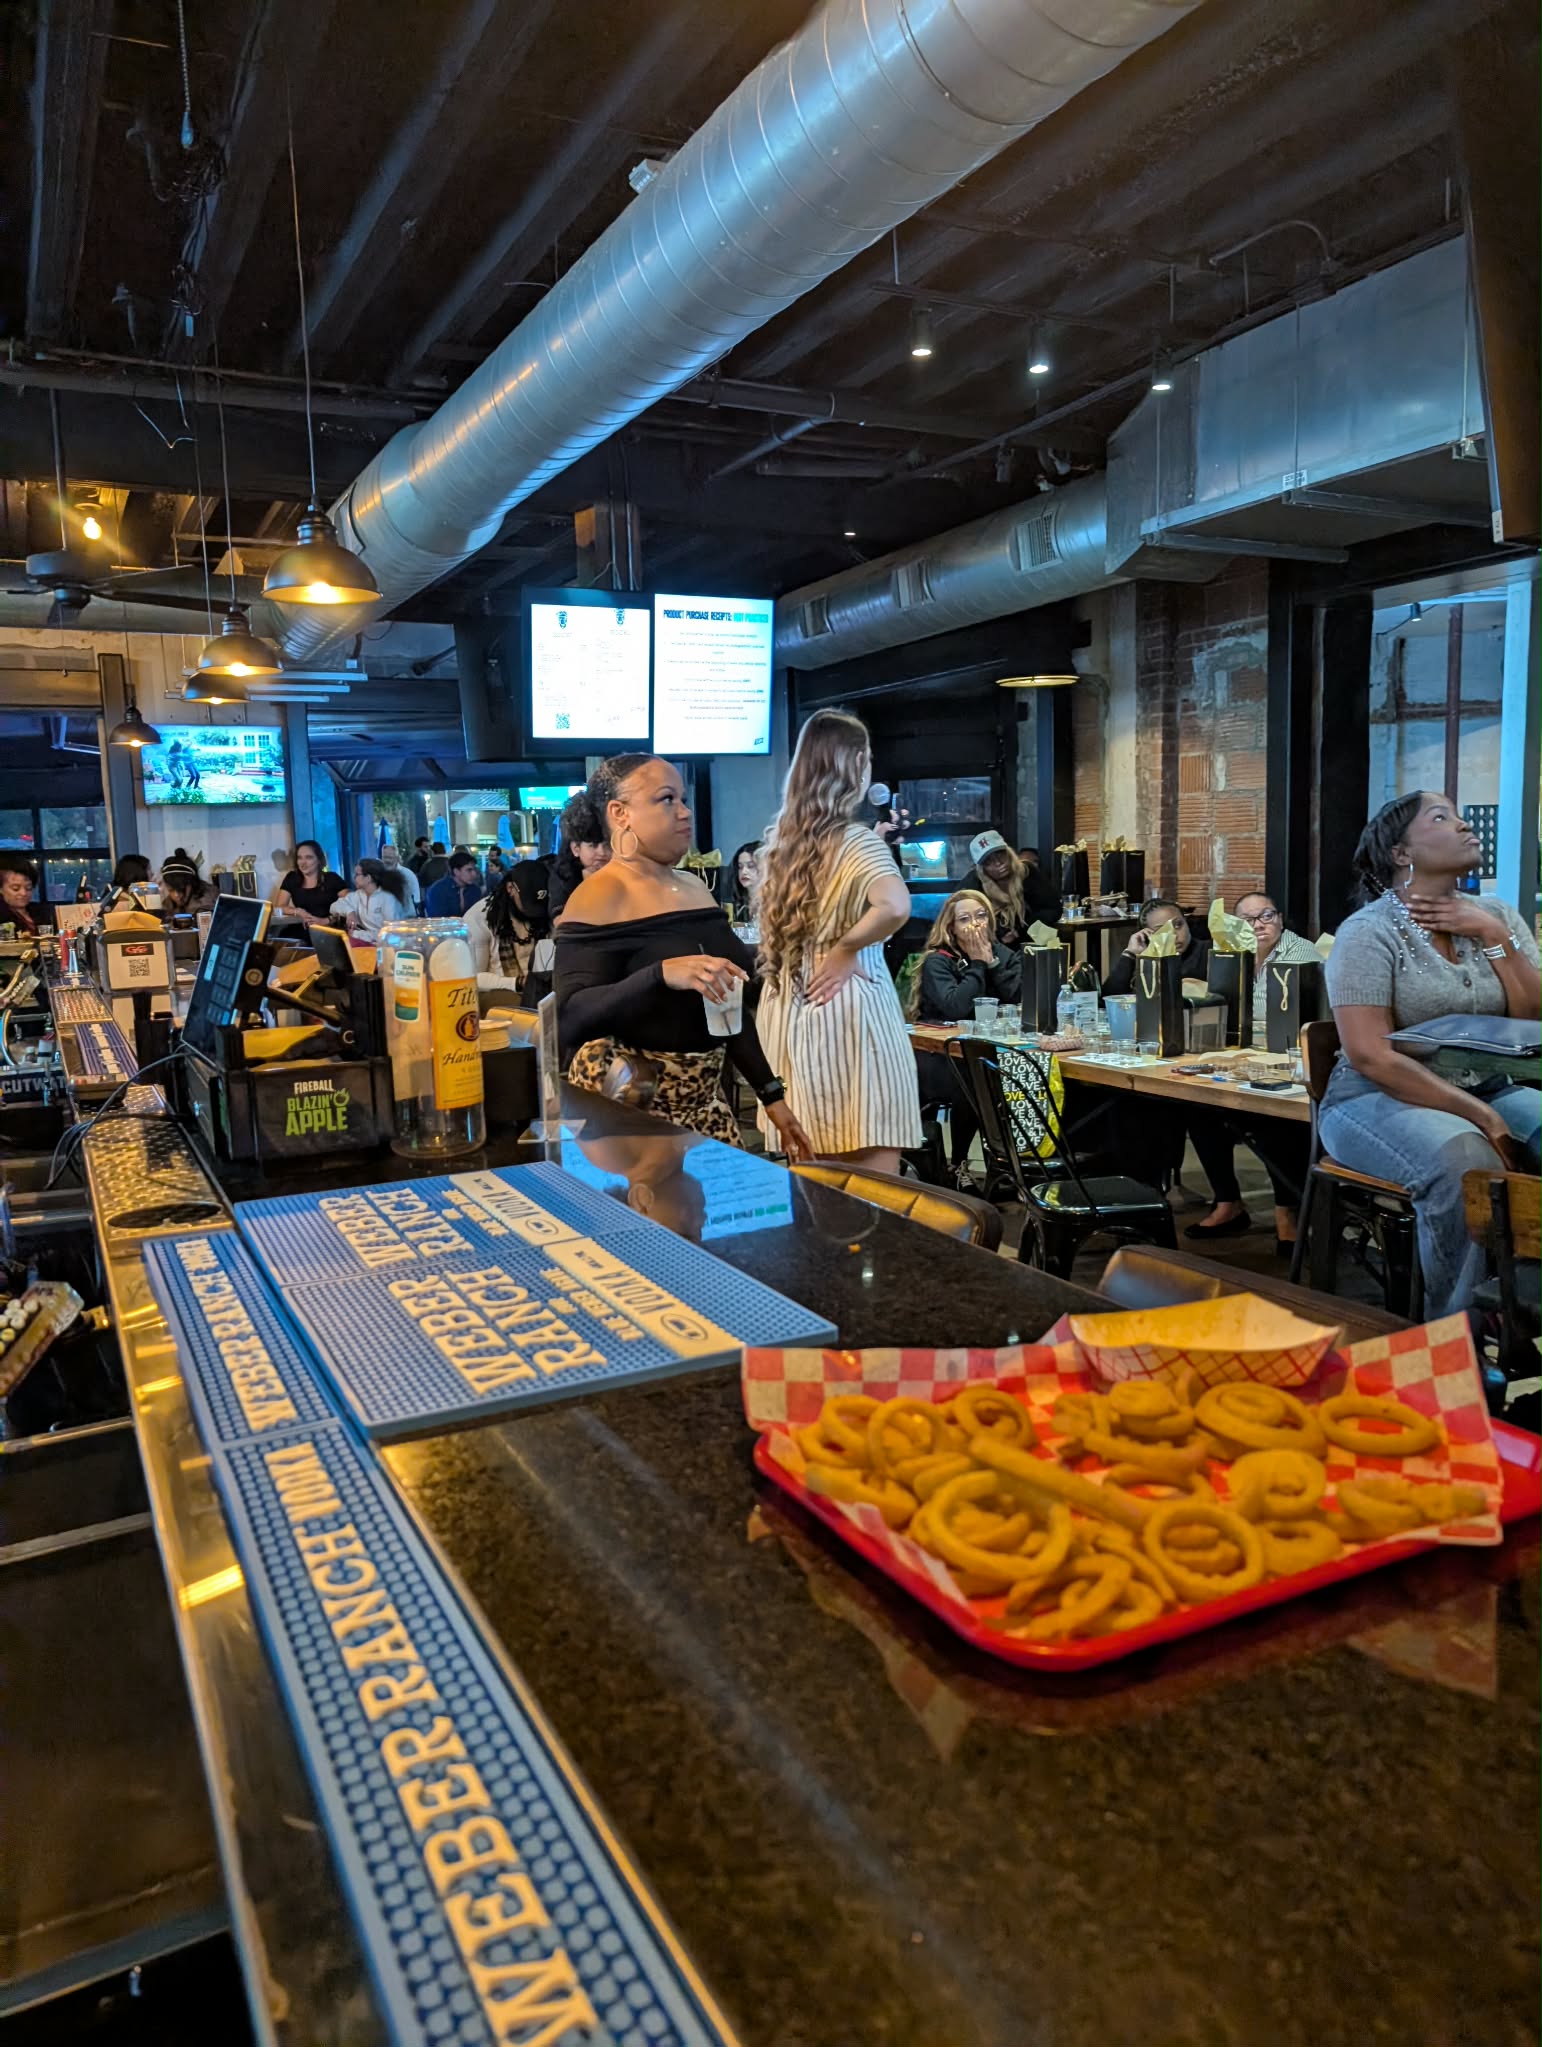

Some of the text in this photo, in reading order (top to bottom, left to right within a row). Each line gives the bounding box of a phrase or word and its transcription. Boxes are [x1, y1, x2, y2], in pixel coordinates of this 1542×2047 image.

[663, 609, 684, 619] PRODUCT
[686, 610, 709, 620] PURCHASE
[294, 1079, 336, 1095] FIREBALL
[1000, 1056, 1026, 1067] LOVE
[285, 1106, 349, 1137] APPLE
[287, 1093, 333, 1112] BLAZIN'
[319, 1193, 418, 1268] WEBER
[365, 1187, 475, 1258] RANCH
[444, 1265, 608, 1376] RANCH
[592, 1269, 676, 1315] VODKA
[388, 1274, 538, 1395] WEBER
[219, 1335, 298, 1433] WEBER
[264, 1441, 600, 2047] WEBER RANCH VODKA
